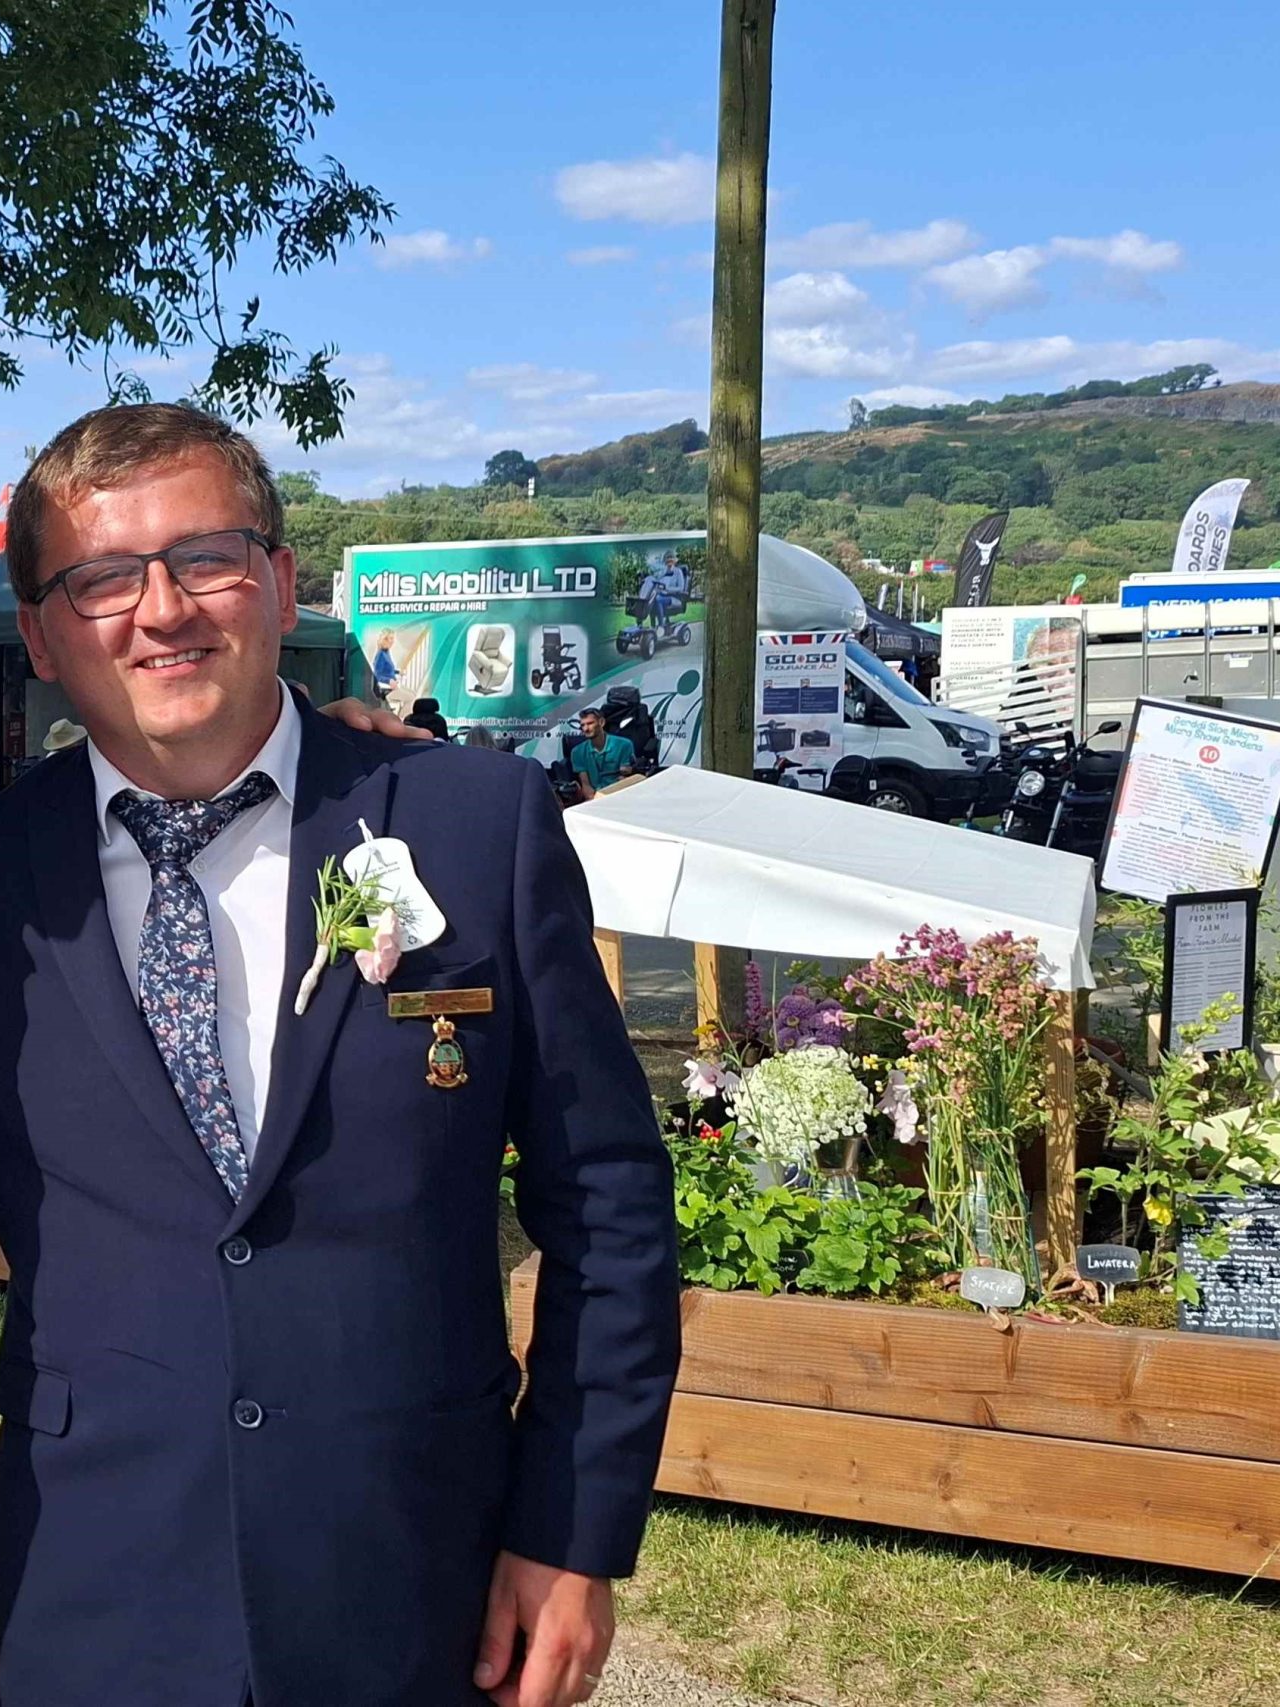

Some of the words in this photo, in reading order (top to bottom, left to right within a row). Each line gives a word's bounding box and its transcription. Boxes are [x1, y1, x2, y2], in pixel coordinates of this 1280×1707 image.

[359, 571, 417, 597] Mills
[421, 567, 528, 597] Mobility
[532, 567, 598, 592] LTD
[359, 604, 384, 613] SALES
[390, 603, 423, 612] SERVICE
[429, 602, 460, 612] REPAIR
[466, 601, 487, 611] HIRE
[1195, 729, 1221, 743] Show
[1202, 748, 1218, 760] 10
[1189, 914, 1212, 922] FROM
[1216, 912, 1229, 920] THE
[1087, 1255, 1137, 1269] LAVATERA
